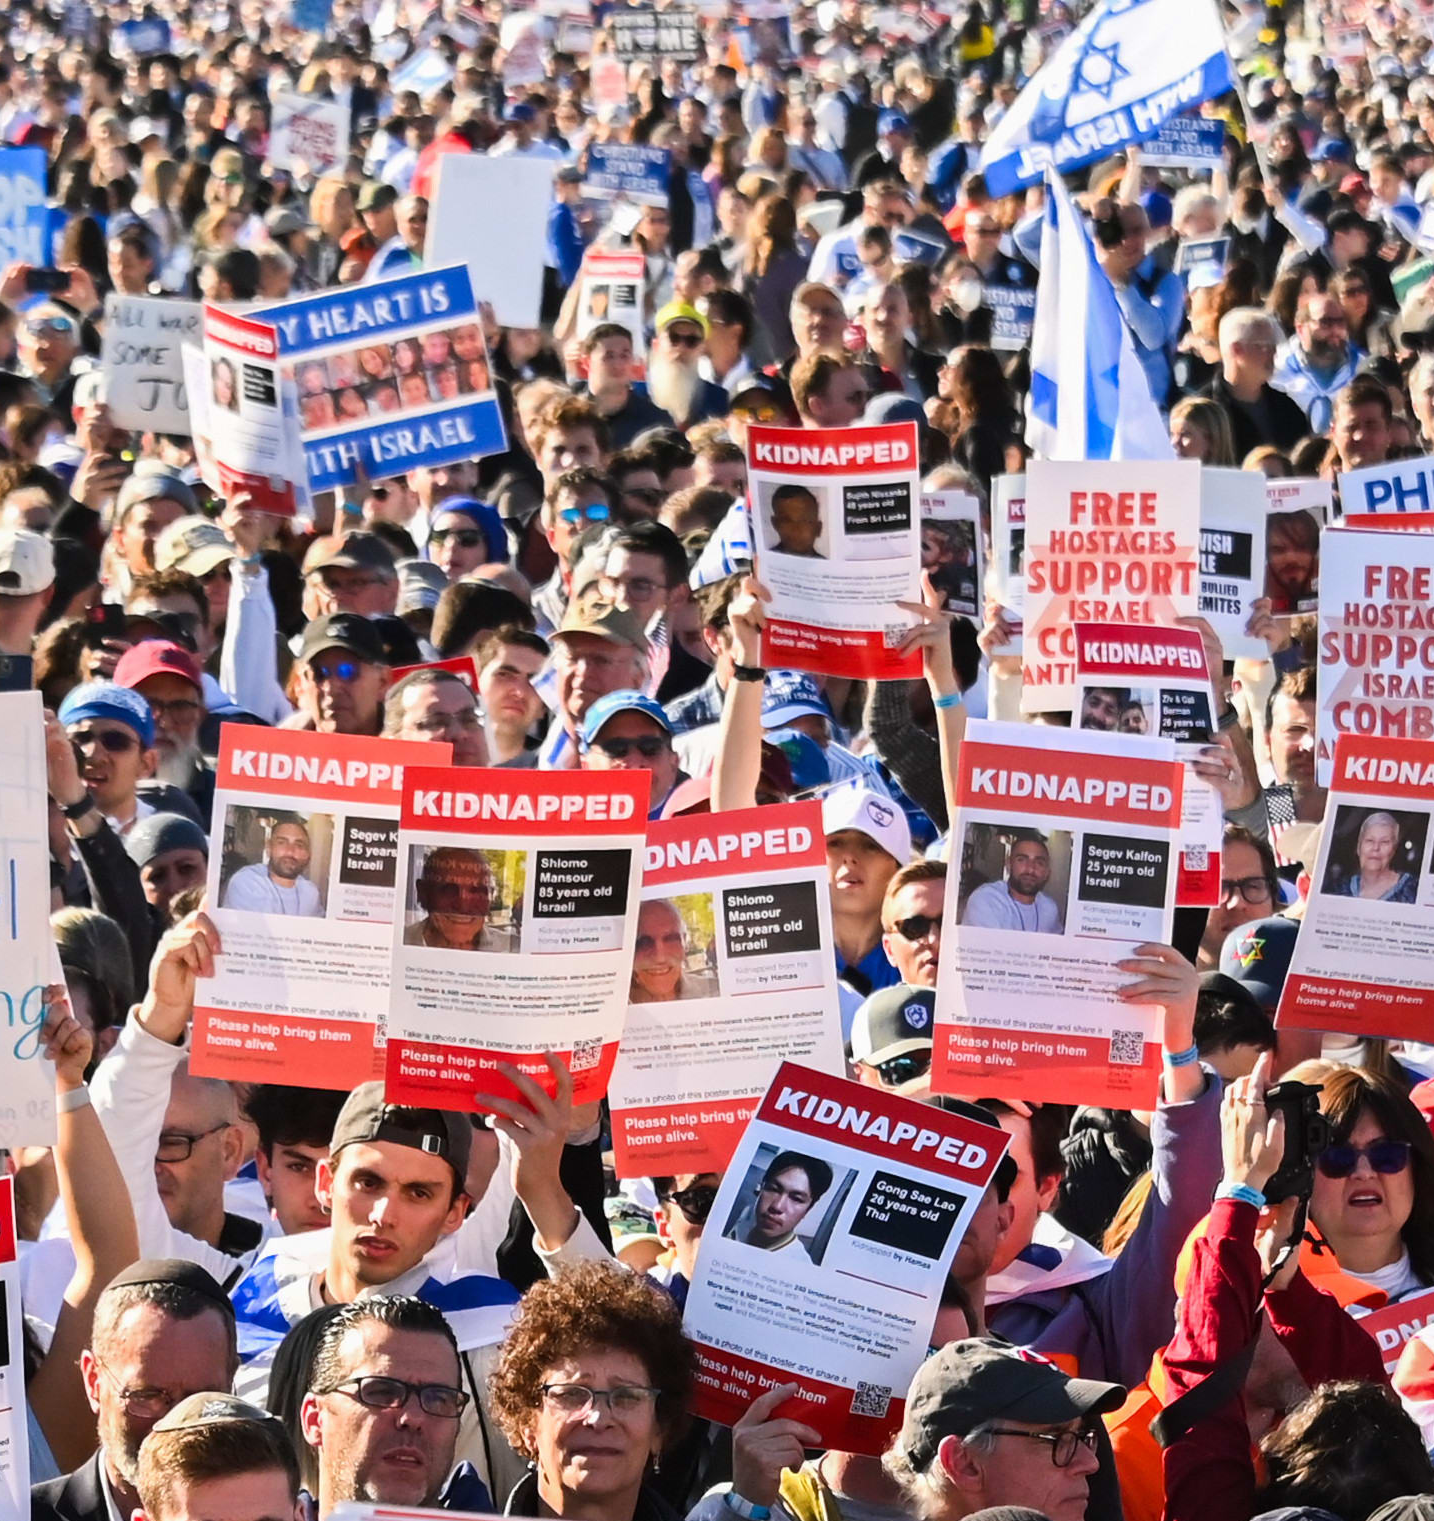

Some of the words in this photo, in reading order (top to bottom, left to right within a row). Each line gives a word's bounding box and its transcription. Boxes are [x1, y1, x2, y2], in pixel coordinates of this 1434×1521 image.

[1143, 141, 1173, 154] WITH
[1176, 143, 1215, 157] ISRAEL
[1158, 130, 1198, 143] STAND
[309, 296, 412, 340] HEART
[421, 282, 449, 314] IS
[113, 345, 170, 365] SOME
[371, 416, 475, 462] ISRAEL
[755, 441, 909, 466] KIDNAPPED
[847, 515, 868, 524] From
[870, 514, 882, 523] Sri
[883, 512, 907, 522] Lanka
[1070, 492, 1157, 526] FREE
[1049, 530, 1176, 556] HOSTAGES
[1027, 561, 1196, 595] SUPPORT
[1202, 582, 1238, 596] BULLIED
[1069, 601, 1155, 623] ISRAEL
[1084, 642, 1203, 669] KIDNAPPED
[971, 765, 1172, 812] KIDNAPPED
[412, 788, 635, 823] KIDNAPPED
[541, 856, 590, 872] Shlomo
[1087, 844, 1125, 863] Segev
[1127, 847, 1164, 864] Kalfon
[540, 871, 595, 888] Mansour
[774, 1086, 990, 1171] KIDNAPPED
[875, 1179, 903, 1201] Gong
[905, 1188, 927, 1205] Sae
[930, 1195, 956, 1211] Lao
